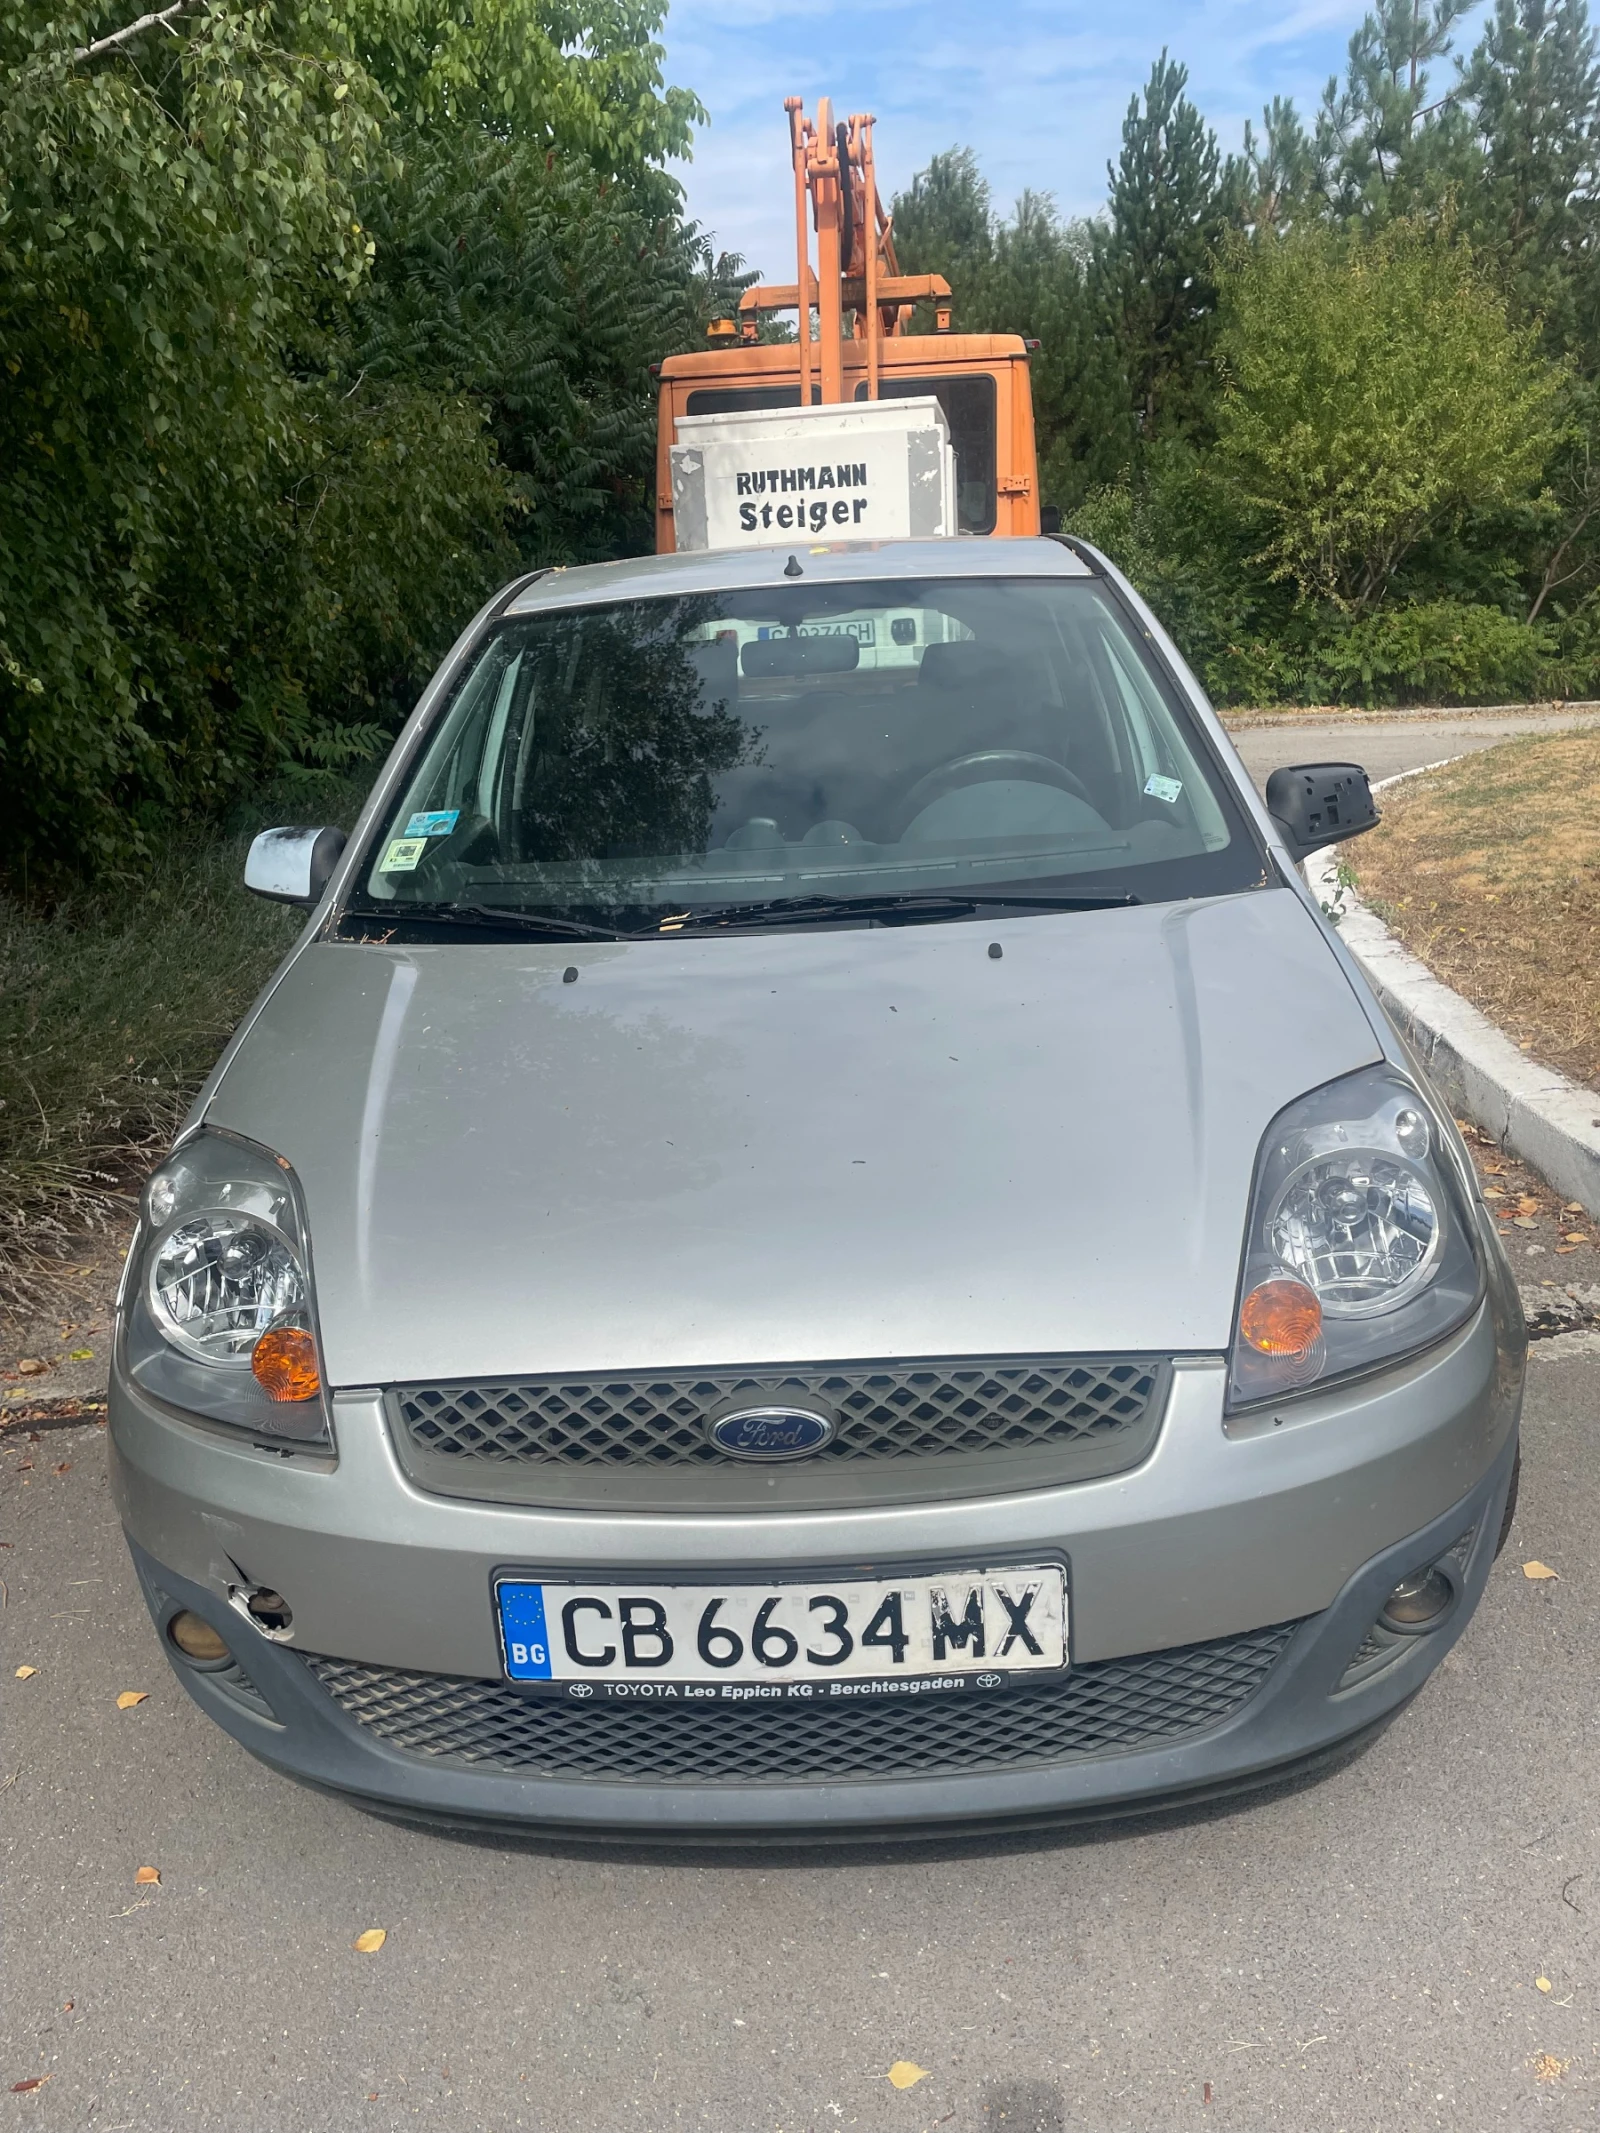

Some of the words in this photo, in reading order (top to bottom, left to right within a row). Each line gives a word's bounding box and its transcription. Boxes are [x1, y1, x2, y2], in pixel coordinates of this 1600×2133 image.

[736, 463, 867, 495] RUTHMANN
[739, 498, 868, 533] Steiger
[846, 623, 870, 641] CH
[737, 1418, 802, 1447] Ford
[561, 1596, 674, 1668] CB
[696, 1590, 910, 1668] 6634
[930, 1581, 1045, 1661] MX
[511, 1643, 546, 1665] BG
[603, 1683, 679, 1697] TOYOTA
[684, 1685, 716, 1697] Leo
[722, 1684, 782, 1700] Eppich
[787, 1685, 813, 1697] KG
[830, 1677, 965, 1697] Berchtesgaden
